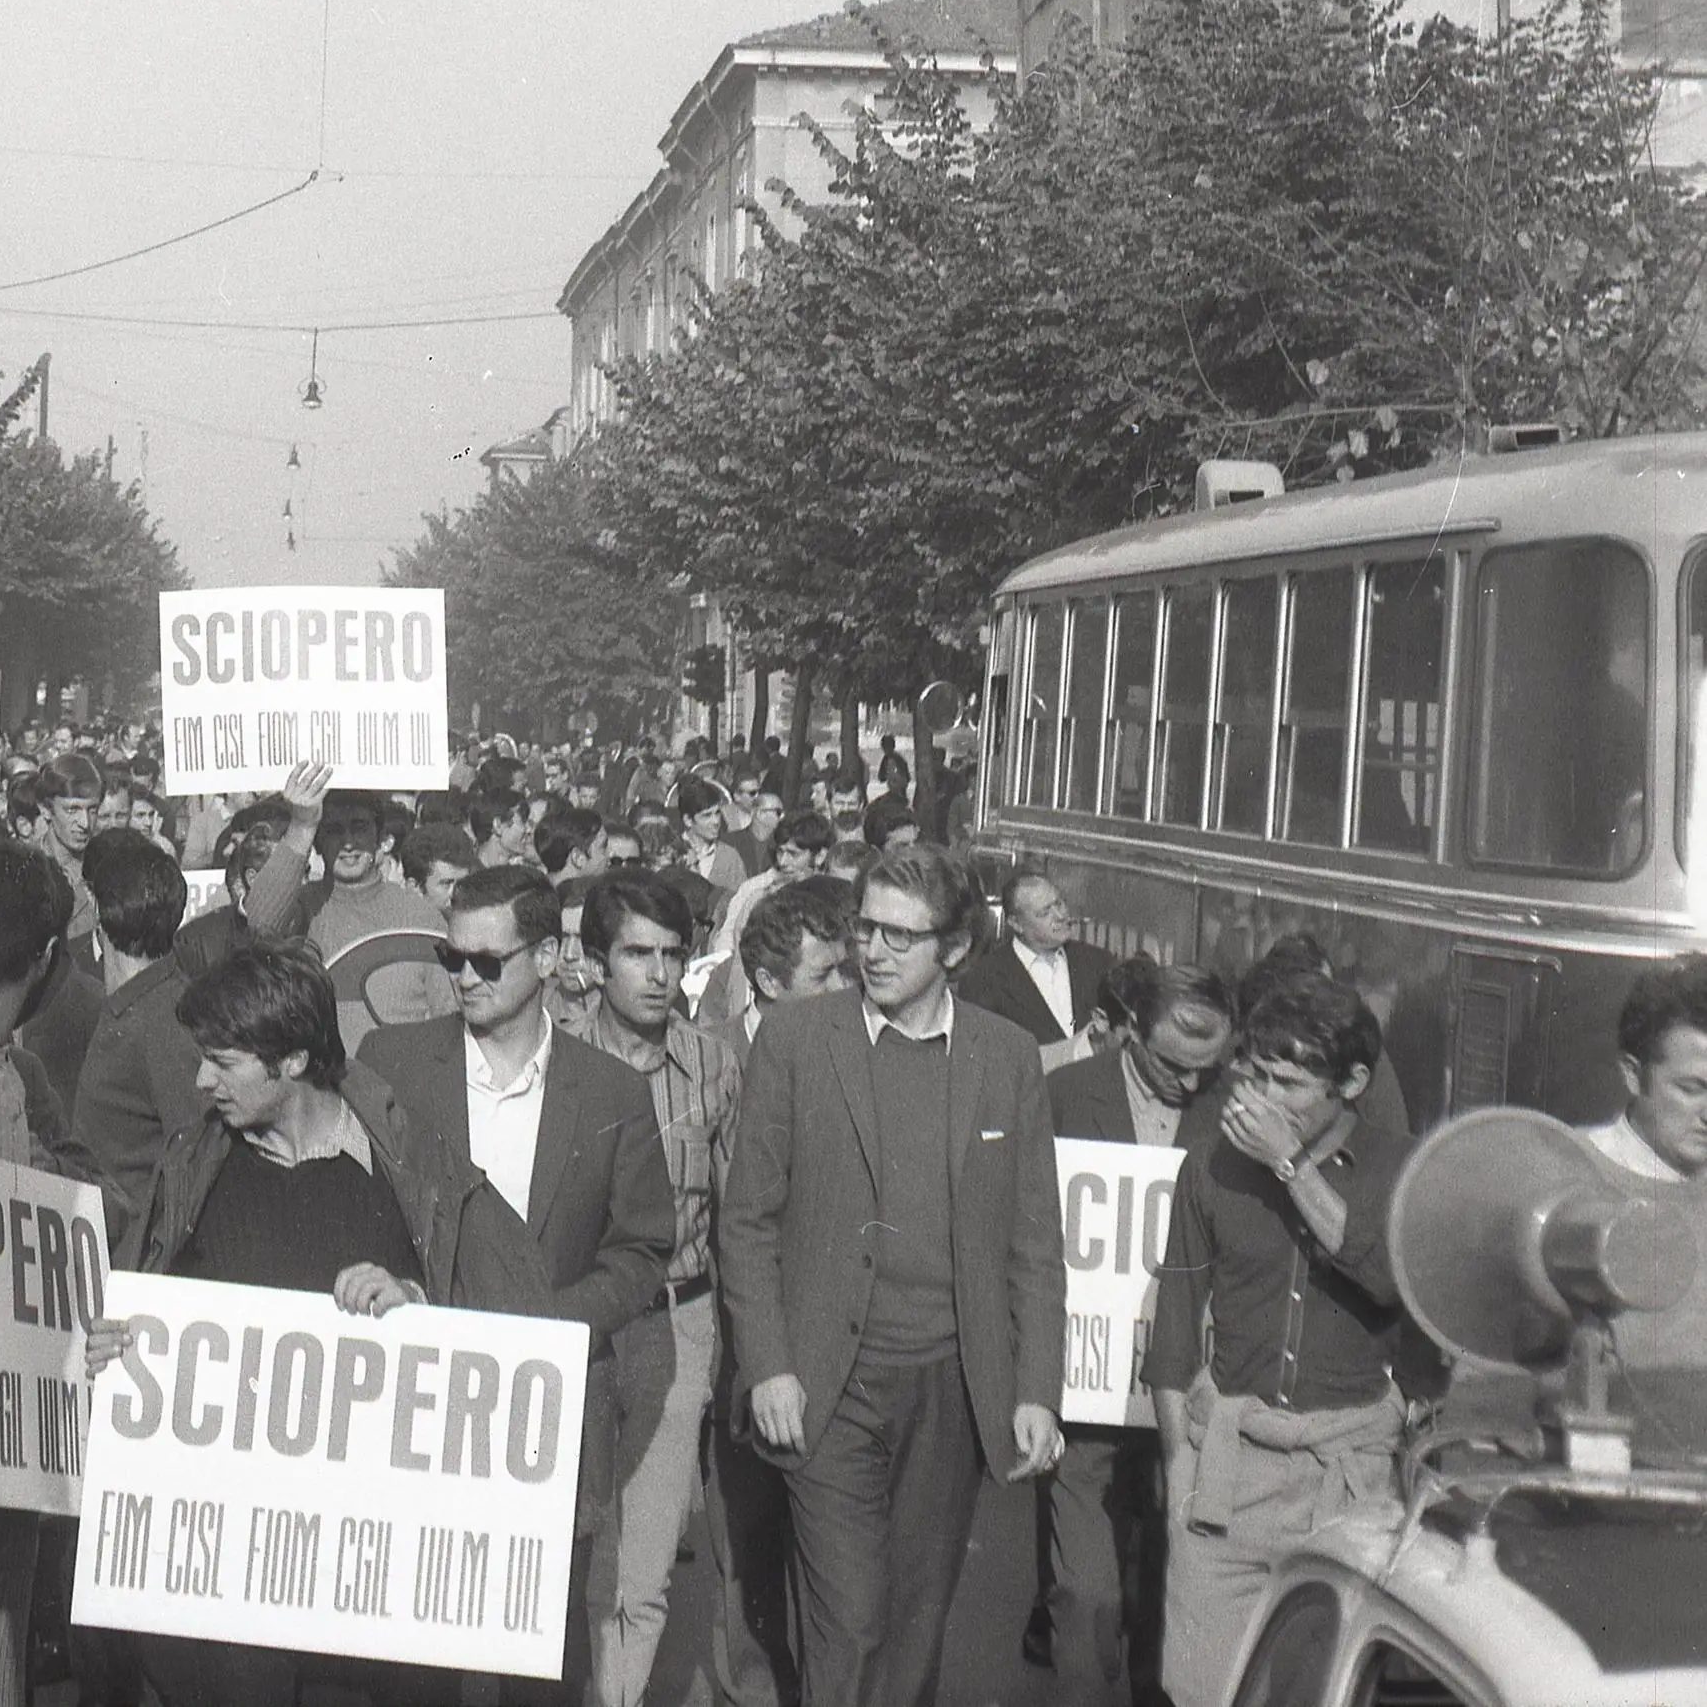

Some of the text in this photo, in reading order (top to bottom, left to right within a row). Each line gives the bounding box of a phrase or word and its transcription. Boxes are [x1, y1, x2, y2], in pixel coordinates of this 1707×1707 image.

[171, 608, 433, 686] SCIOPERO
[174, 710, 435, 772] FIM CISL FIOM CGIL UILM UIL
[1066, 1314, 1113, 1392] CISL
[37, 1376, 81, 1477] UILM
[110, 1313, 564, 1484] SCIOPERO
[94, 1490, 544, 1636] FIM CISL FIOM CGIL UILM UIL
